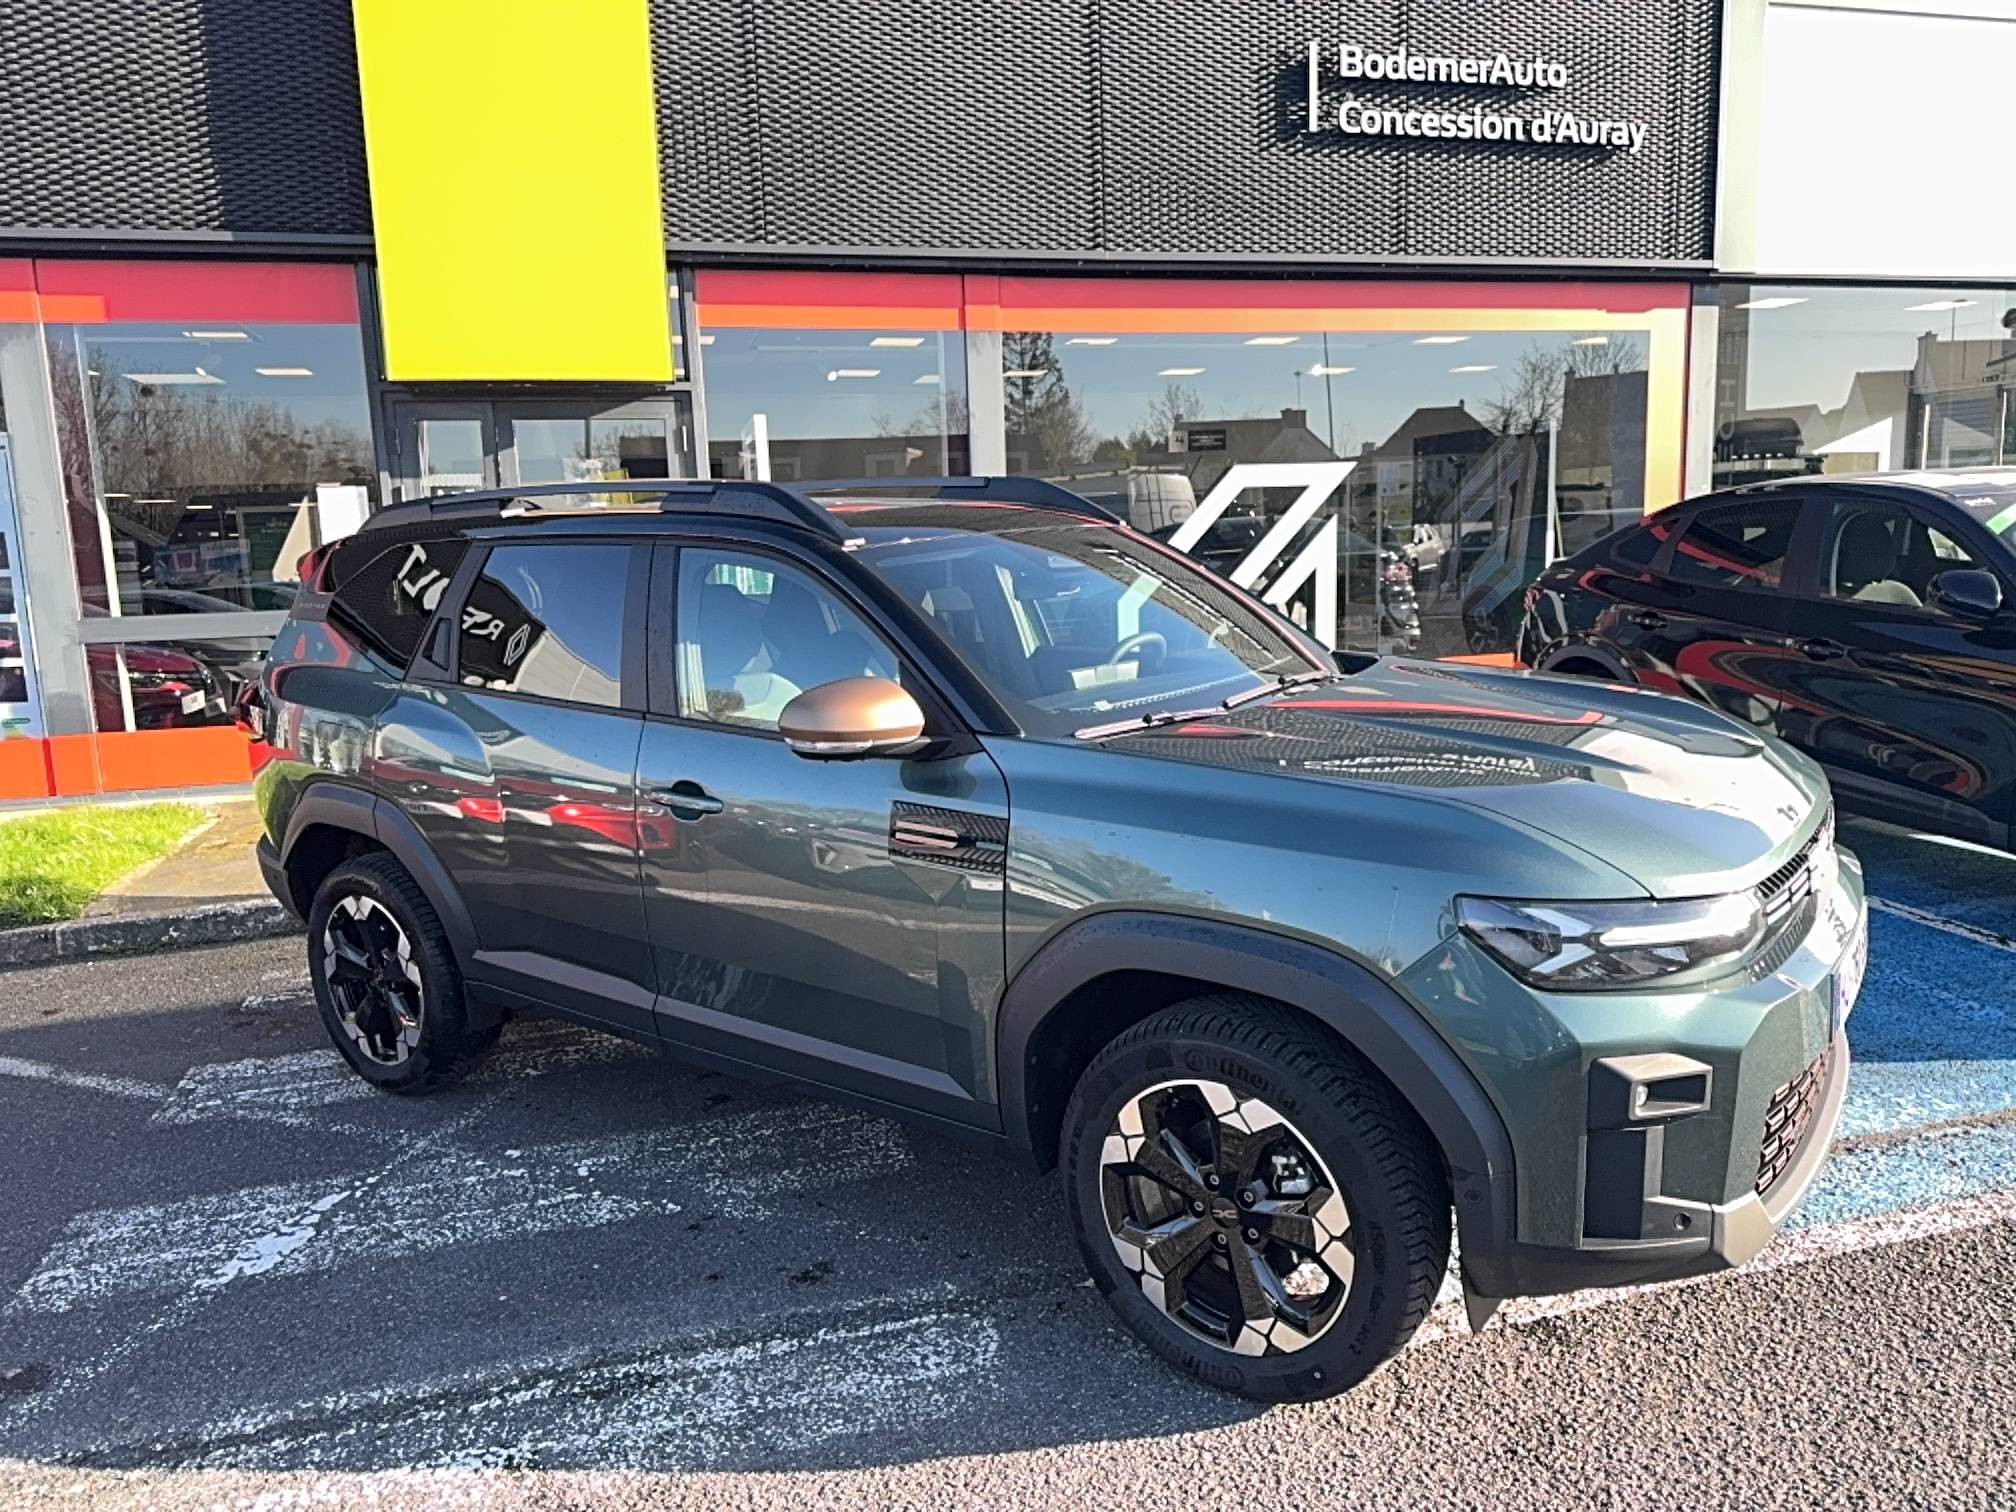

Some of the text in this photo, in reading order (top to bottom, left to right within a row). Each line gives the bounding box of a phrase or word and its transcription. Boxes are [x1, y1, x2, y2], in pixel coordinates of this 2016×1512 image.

[1338, 46, 1567, 88] BodemerAuto
[1338, 101, 1648, 153] Concession d'Auray
